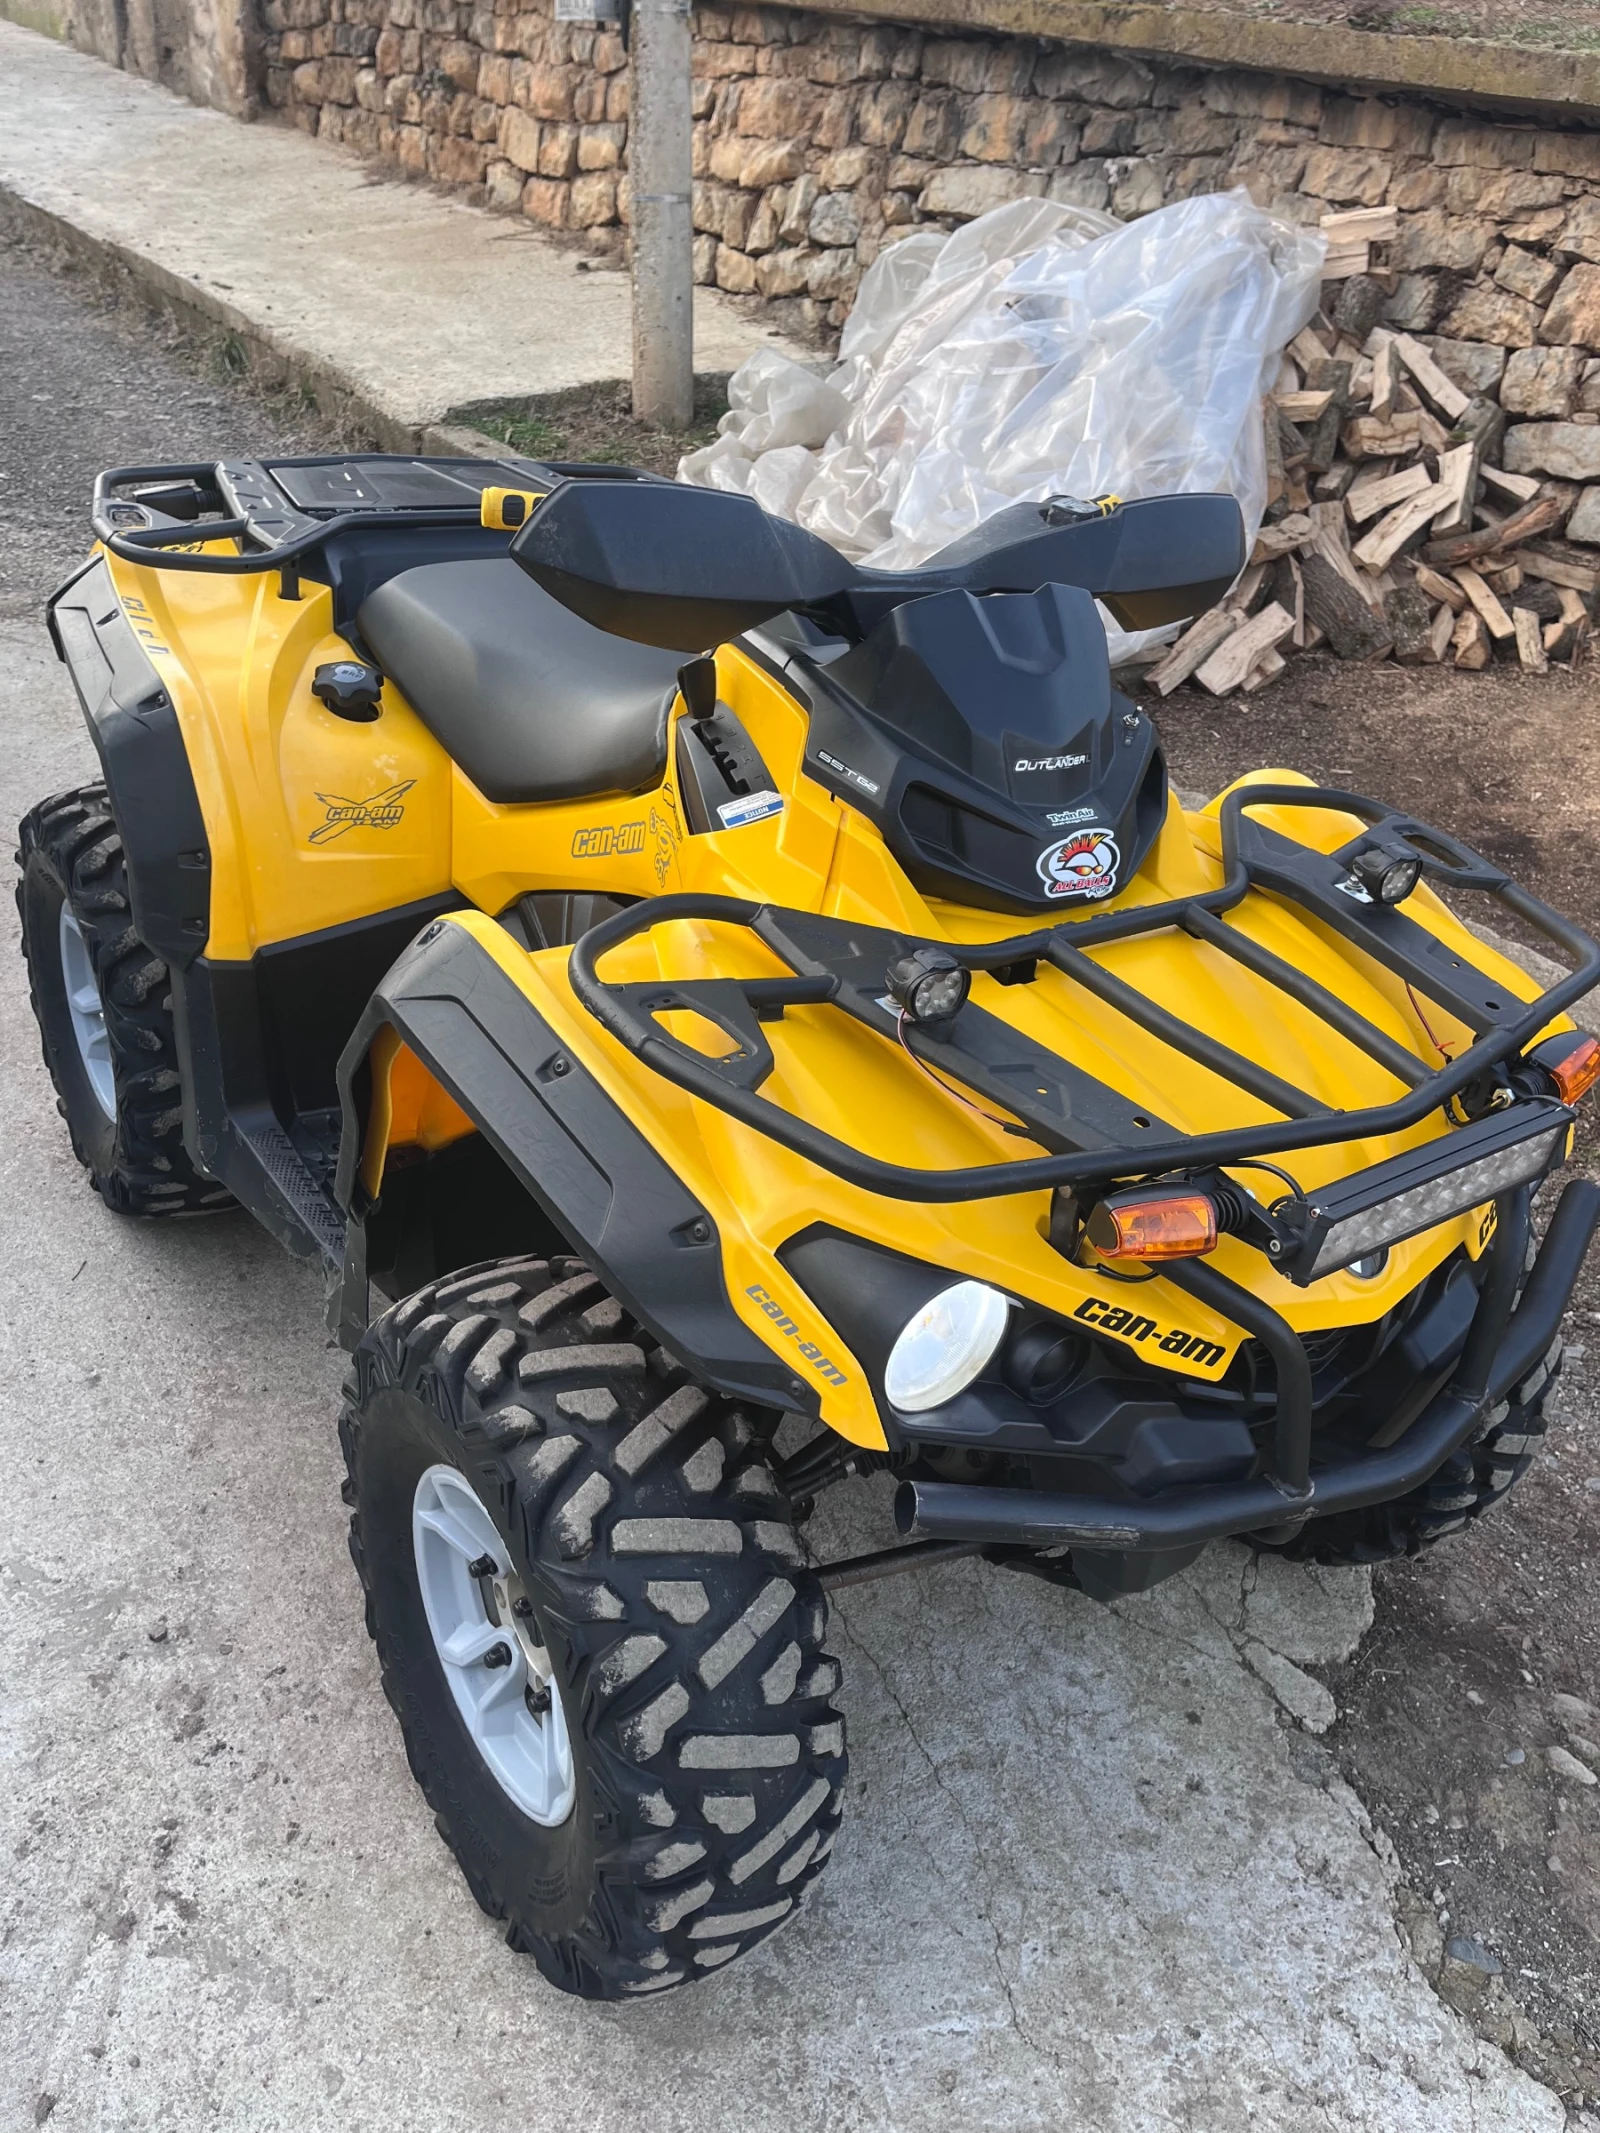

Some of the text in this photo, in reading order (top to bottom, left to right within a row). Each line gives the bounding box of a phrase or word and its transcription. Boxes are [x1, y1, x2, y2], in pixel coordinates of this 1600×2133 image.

[818, 751, 857, 777] SST
[326, 805, 404, 821] can-am
[743, 805, 769, 820] NOTICE
[571, 821, 646, 858] can-am
[1052, 875, 1111, 892] ALL BALLS
[745, 1284, 848, 1386] can-am
[1073, 1297, 1227, 1367] can-am
